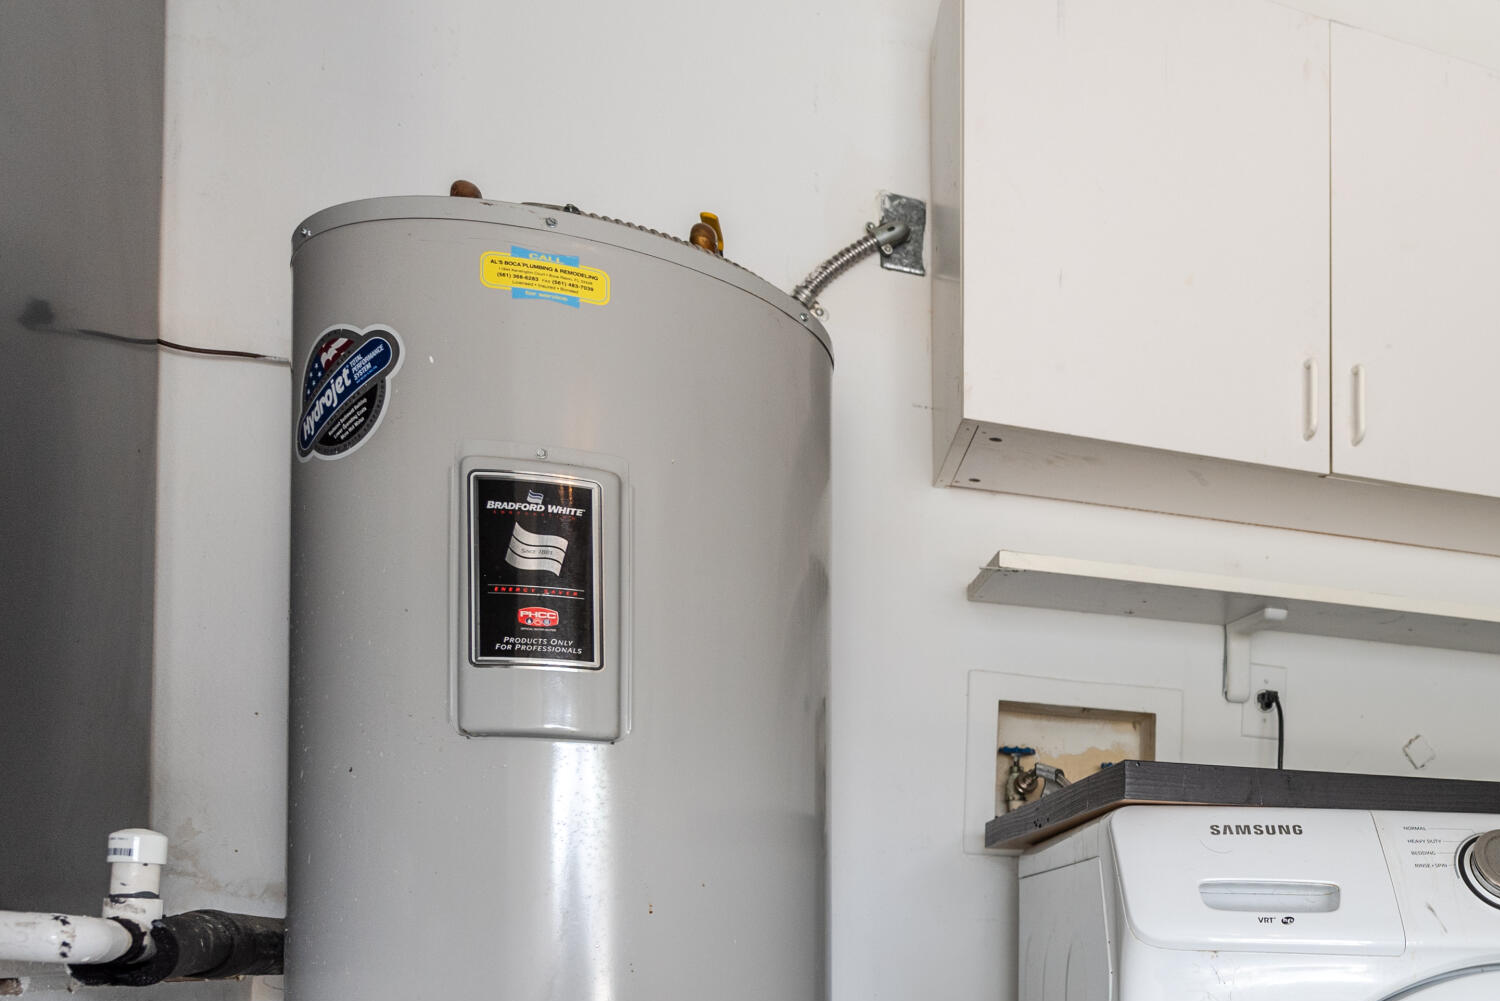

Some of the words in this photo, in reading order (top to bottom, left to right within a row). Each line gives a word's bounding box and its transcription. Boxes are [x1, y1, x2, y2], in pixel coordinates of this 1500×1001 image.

[529, 253, 564, 264] CALL
[522, 262, 553, 272] PLUMBING
[560, 269, 598, 281] REMODELING
[352, 344, 385, 374] PERFORMANCE
[353, 362, 372, 381] SYSTEM
[303, 367, 351, 440] Hydrojet
[487, 500, 545, 512] BRADFORD
[547, 504, 583, 517] WHITE
[520, 611, 556, 619] PHCC
[503, 636, 547, 645] PRODUCTS
[515, 644, 583, 654] PROFESSIONALS
[1210, 824, 1304, 836] SAMSUNG
[1258, 916, 1273, 924] VRT
